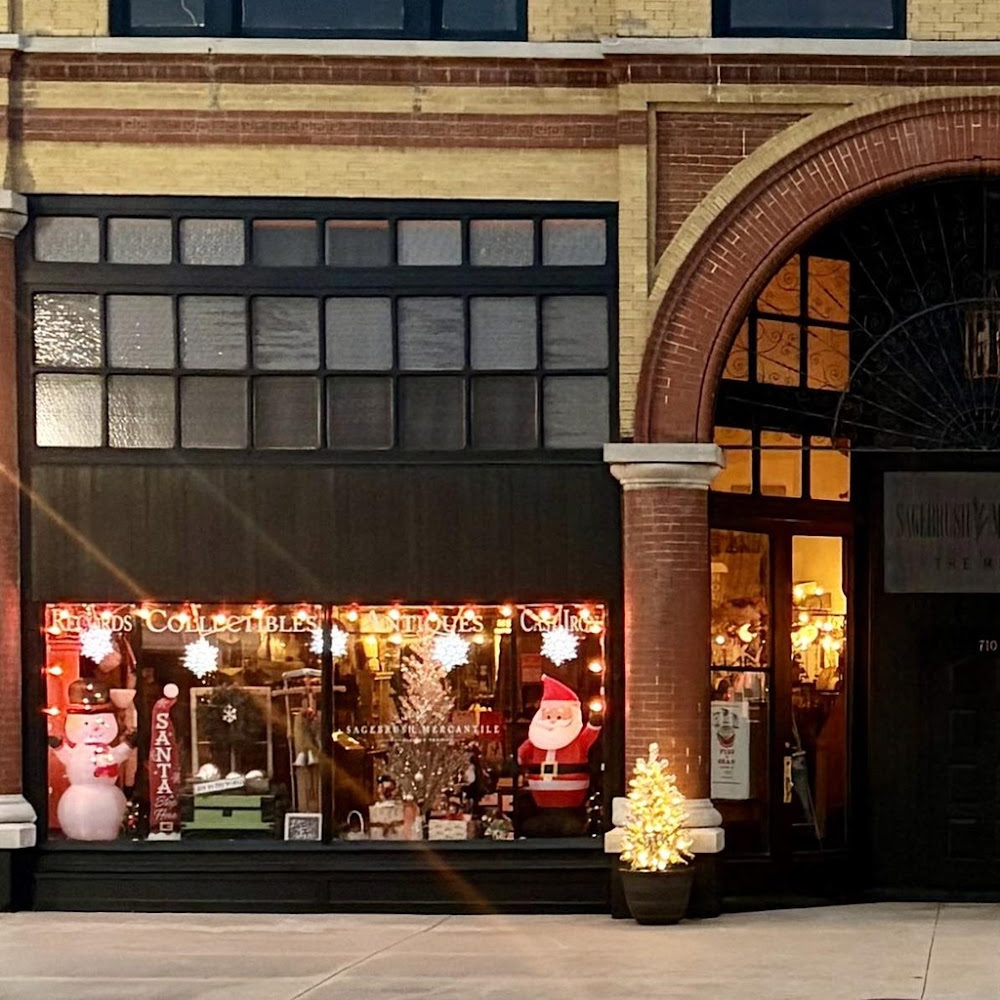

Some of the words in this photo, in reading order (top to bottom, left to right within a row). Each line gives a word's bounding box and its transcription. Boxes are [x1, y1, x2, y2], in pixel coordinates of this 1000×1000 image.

[934, 557, 970, 571] THE
[145, 609, 318, 633] COLLECTIBLES
[978, 639, 998, 652] 710
[154, 712, 173, 795] SANTA
